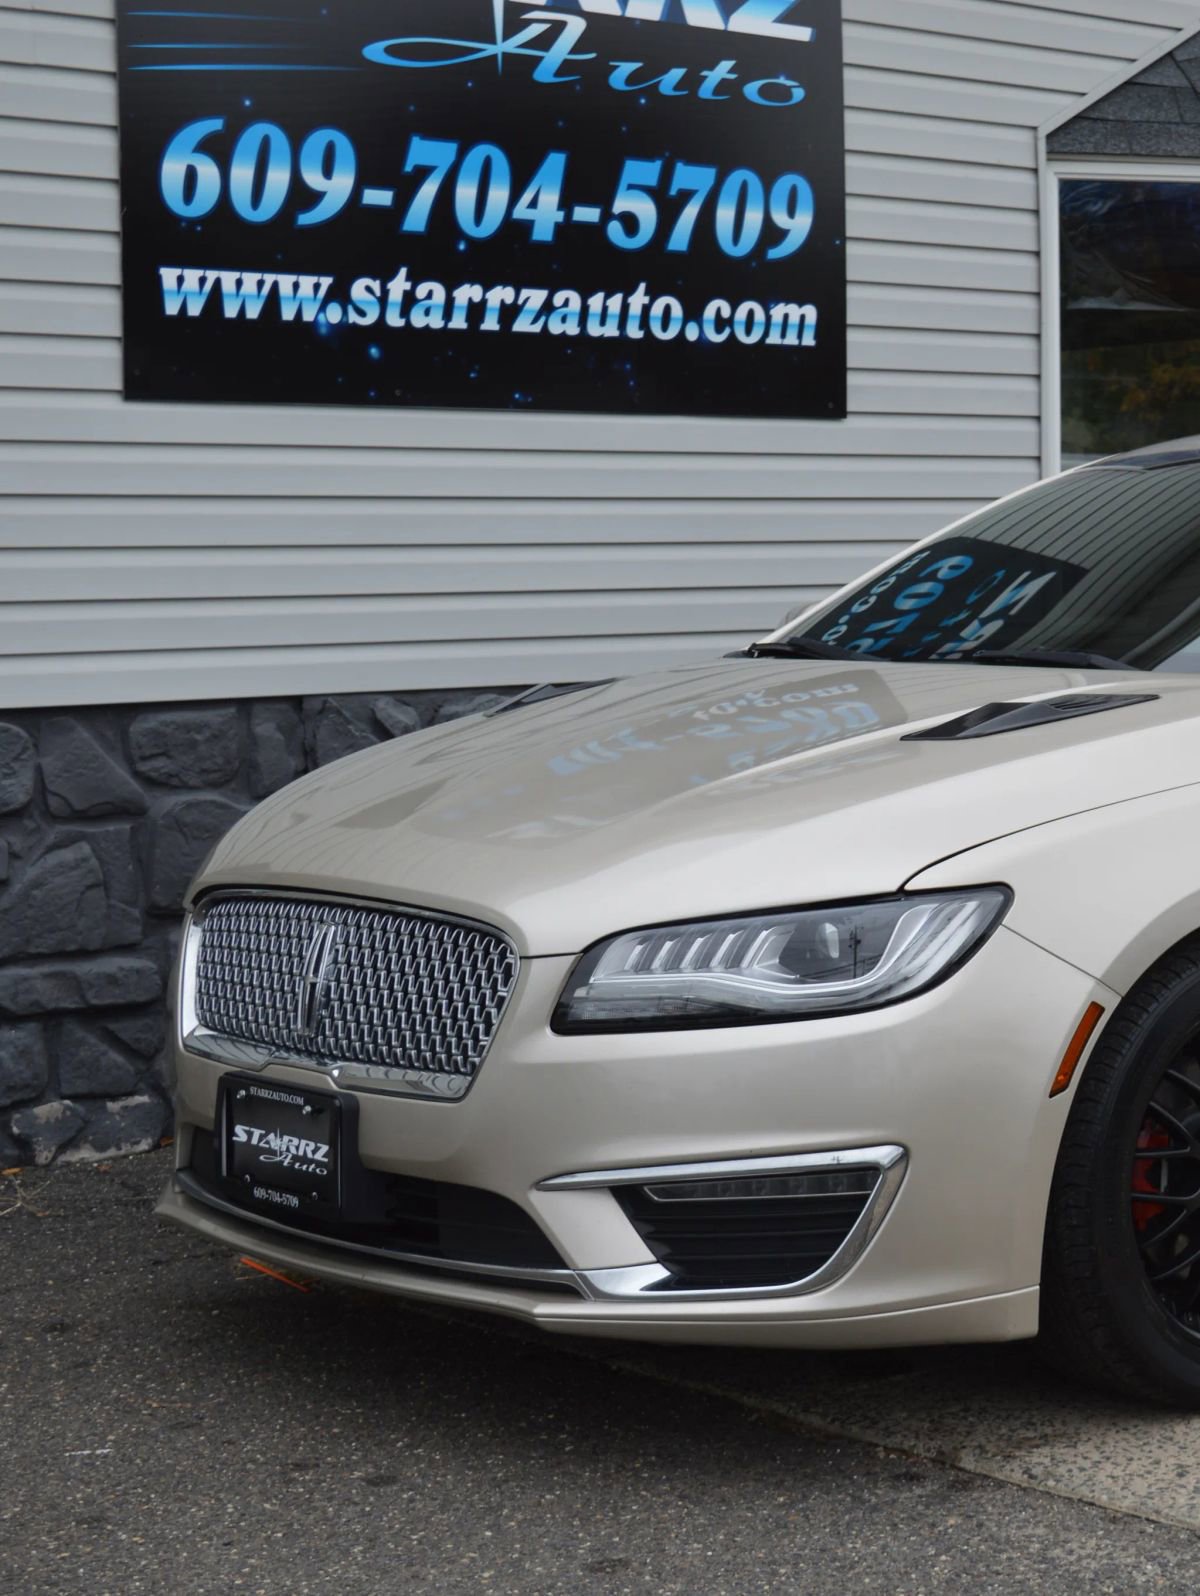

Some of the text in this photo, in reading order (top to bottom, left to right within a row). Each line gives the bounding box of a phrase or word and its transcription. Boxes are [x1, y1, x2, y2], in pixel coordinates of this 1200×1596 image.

[362, 11, 806, 107] Auto
[159, 117, 815, 261] 609-704-5709
[157, 266, 818, 347] www.starrzauto.com
[250, 1086, 304, 1105] STARRZAUTO.COM
[232, 1124, 329, 1162] STARRZ
[259, 1152, 328, 1176] Auto
[253, 1186, 299, 1208] 609-704-5709
